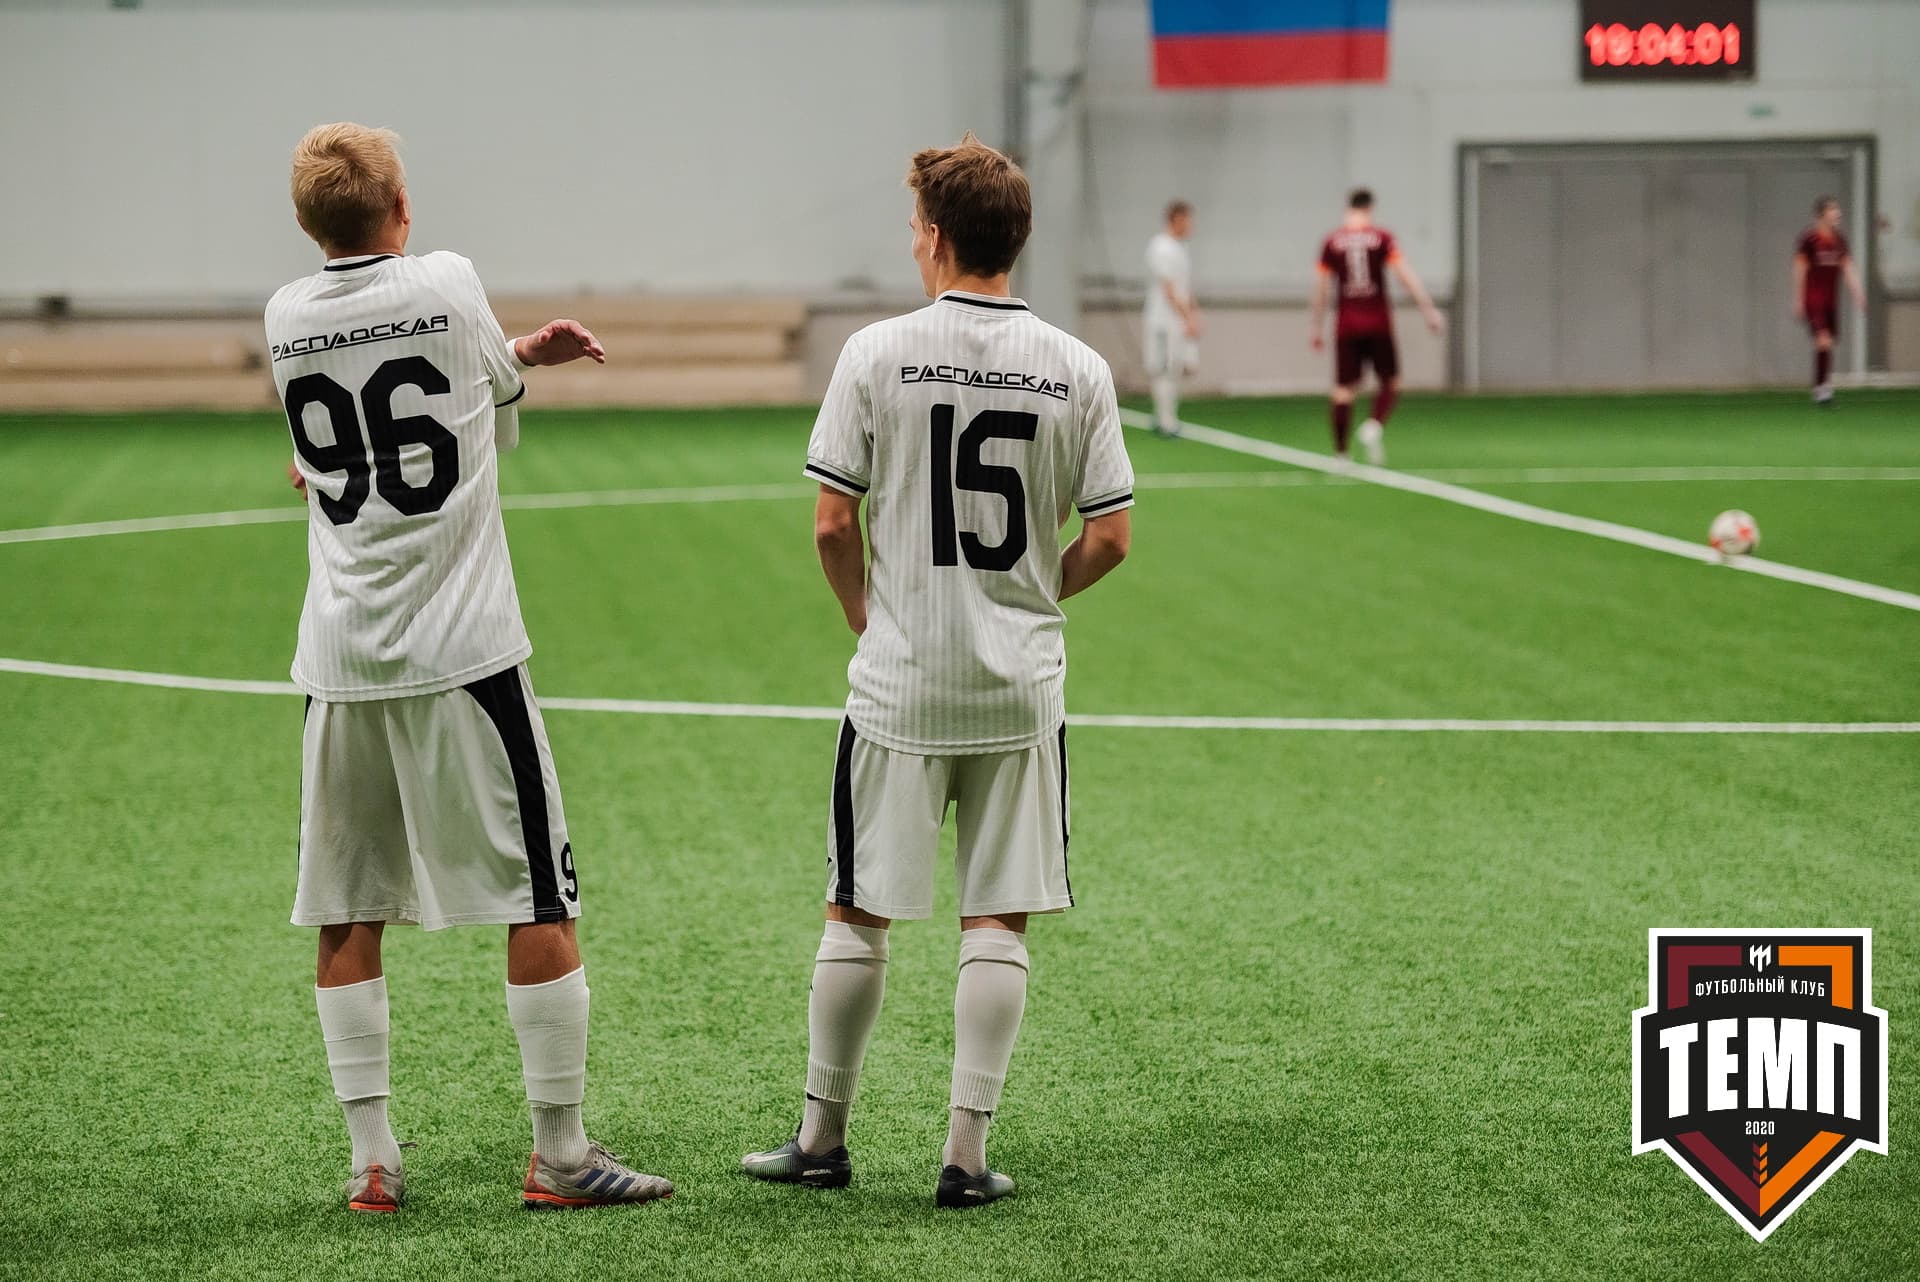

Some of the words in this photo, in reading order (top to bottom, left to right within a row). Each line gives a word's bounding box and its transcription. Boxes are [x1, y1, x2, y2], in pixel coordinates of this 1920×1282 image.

[272, 314, 449, 362] РАСПАДСКАЯ
[901, 364, 1069, 401] РАСПАДСКАЯ
[285, 355, 459, 526] 96
[931, 404, 1039, 572] 15
